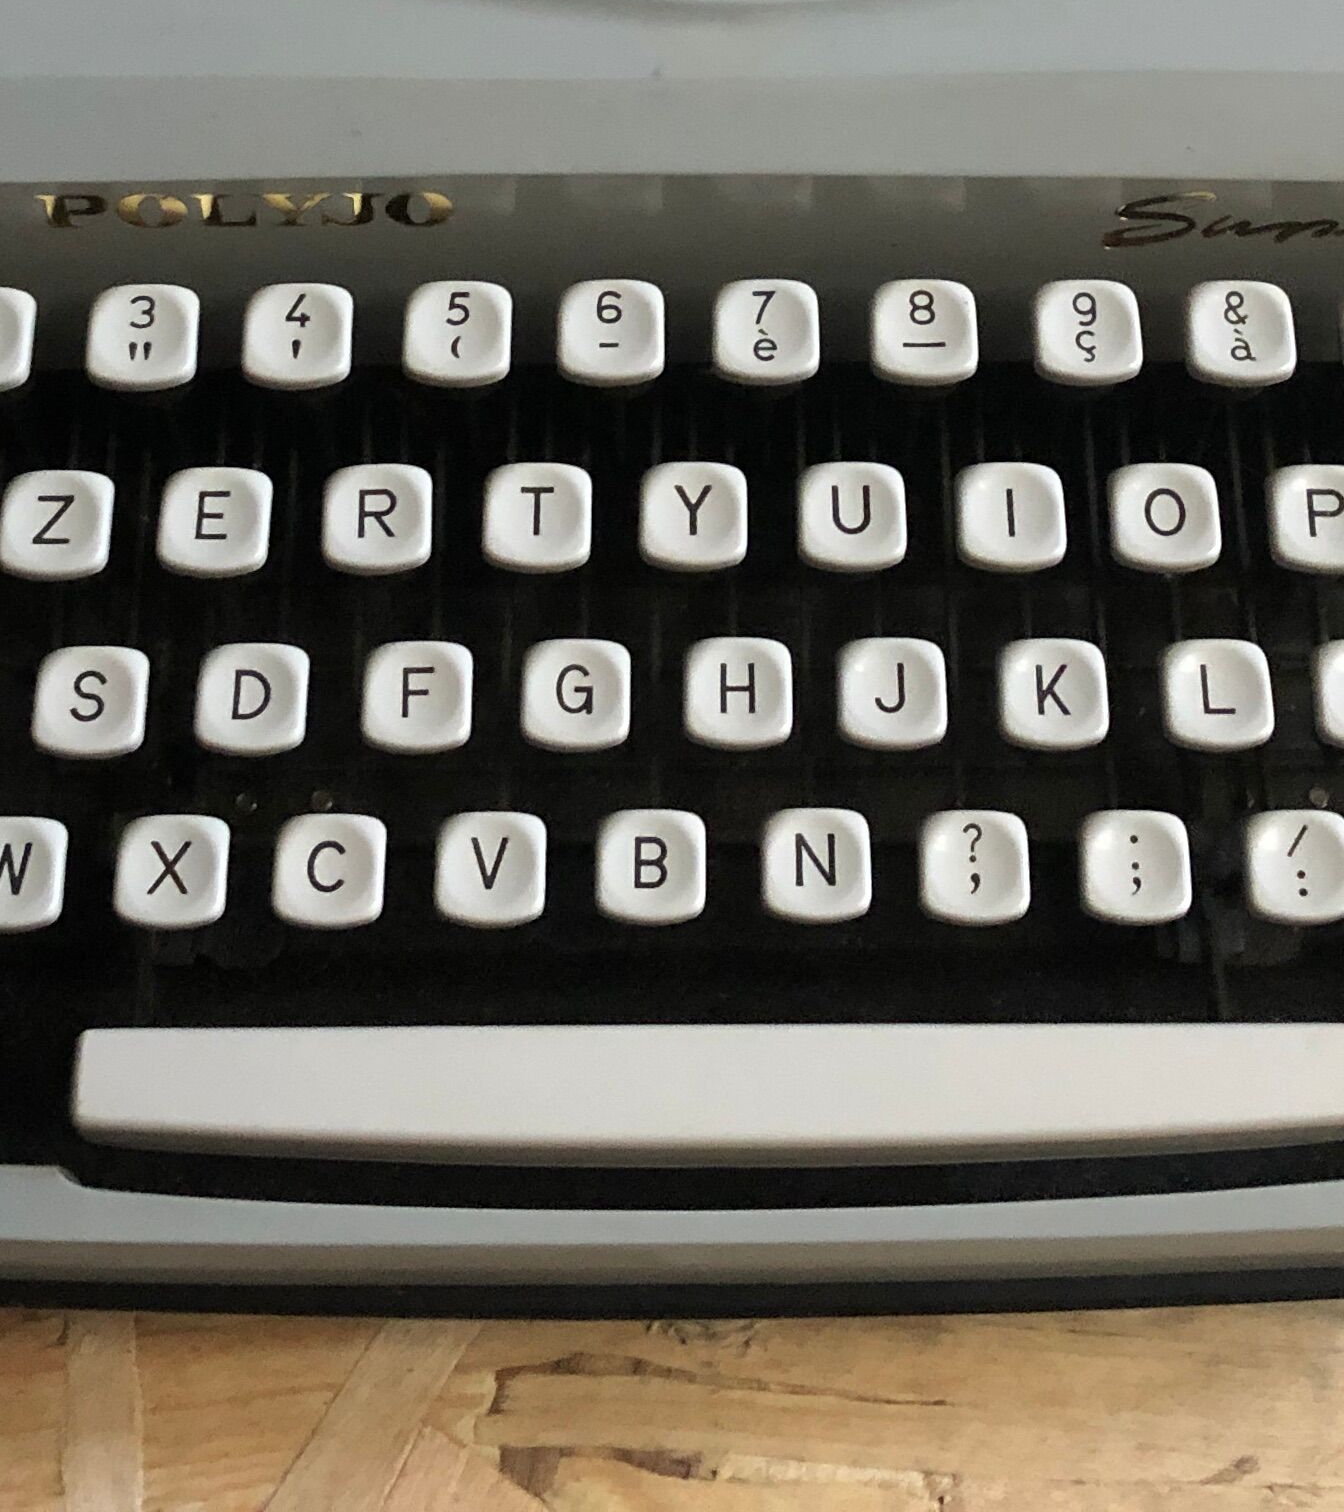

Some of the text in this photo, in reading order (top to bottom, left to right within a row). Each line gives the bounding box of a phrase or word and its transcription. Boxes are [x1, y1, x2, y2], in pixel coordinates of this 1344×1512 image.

[33, 191, 454, 229] POLYJO
[129, 295, 156, 330] 3
[285, 293, 311, 328] 4
[445, 291, 471, 327] 5
[596, 290, 623, 324] 6
[751, 290, 777, 325] 7
[908, 289, 936, 326] 8
[1072, 291, 1097, 327] 9
[1223, 290, 1249, 326] &
[753, 328, 778, 362] è
[1075, 330, 1097, 363] ç
[1230, 328, 1257, 362] à
[31, 494, 76, 545] Z
[194, 490, 232, 541] E
[357, 488, 398, 539] R
[520, 486, 555, 536] T
[674, 484, 713, 536] Y
[831, 484, 872, 535] U
[1005, 488, 1016, 538] I
[1144, 487, 1187, 537] O
[69, 670, 108, 723] S
[231, 669, 272, 721] D
[401, 665, 436, 719] F
[555, 663, 594, 716] G
[719, 662, 756, 714] H
[874, 662, 906, 714] J
[1035, 663, 1072, 716] K
[1199, 664, 1237, 716] L
[146, 840, 193, 895] X
[306, 840, 347, 893] C
[470, 836, 510, 890] V
[633, 836, 668, 889] B
[795, 832, 837, 887] N
[962, 822, 983, 863] ?
